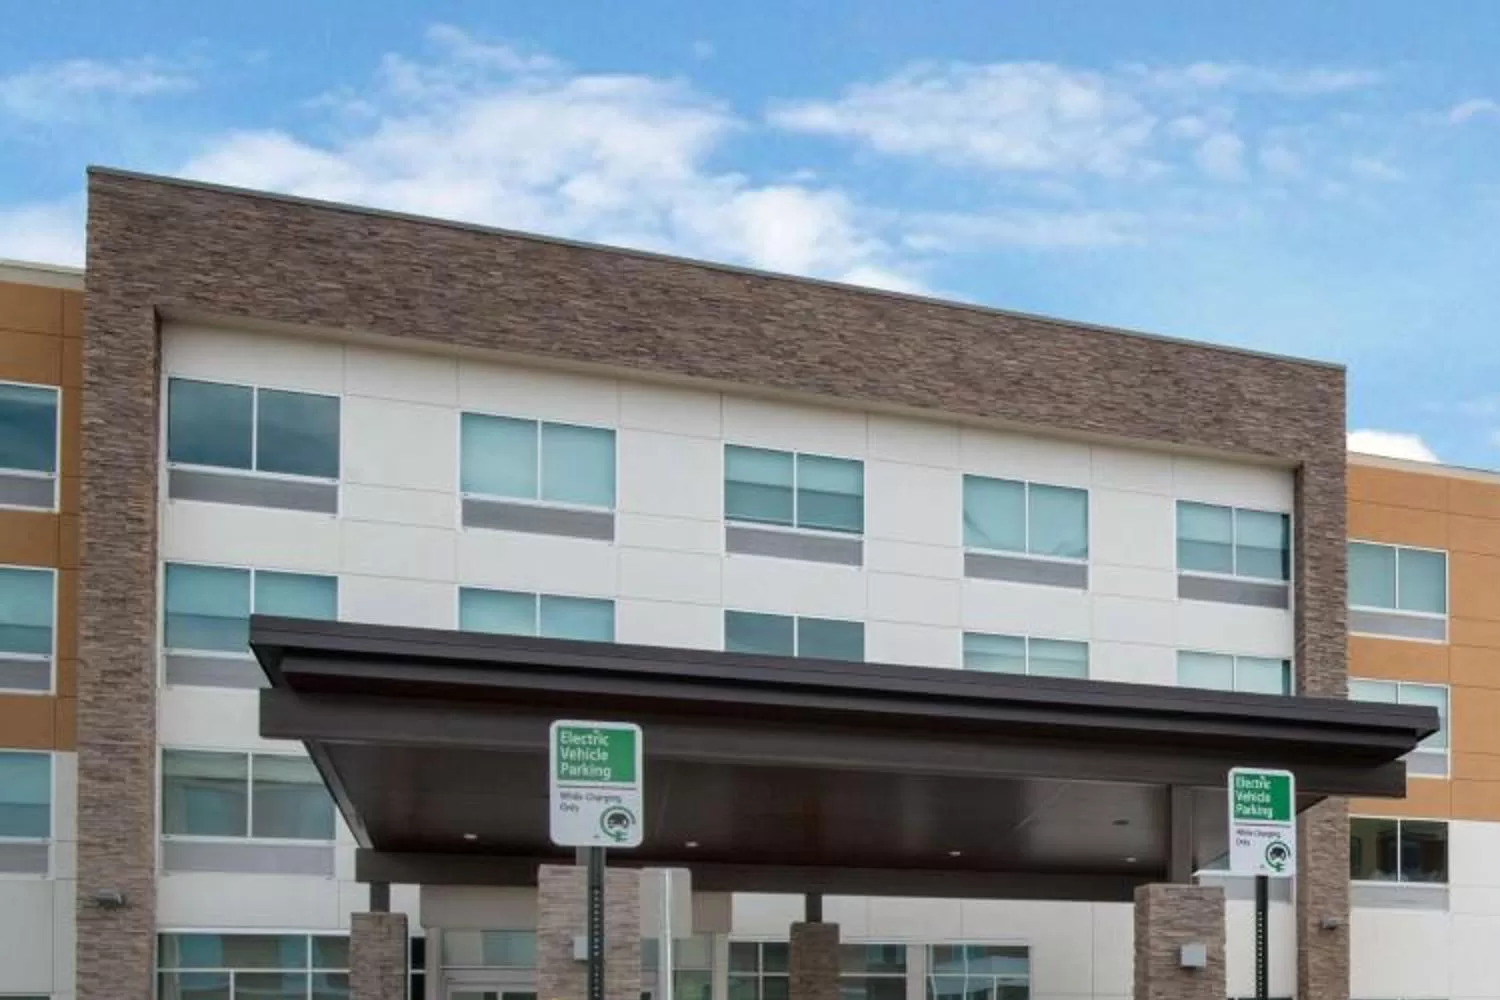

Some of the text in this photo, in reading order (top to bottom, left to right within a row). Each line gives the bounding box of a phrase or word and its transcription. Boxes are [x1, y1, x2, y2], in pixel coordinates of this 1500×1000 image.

[560, 730, 609, 745] Electric
[560, 747, 608, 761] Vehicle
[560, 762, 611, 780] Parking
[1236, 776, 1271, 789] Electric
[1235, 790, 1271, 802] Vehicle
[1236, 804, 1273, 818] Parking
